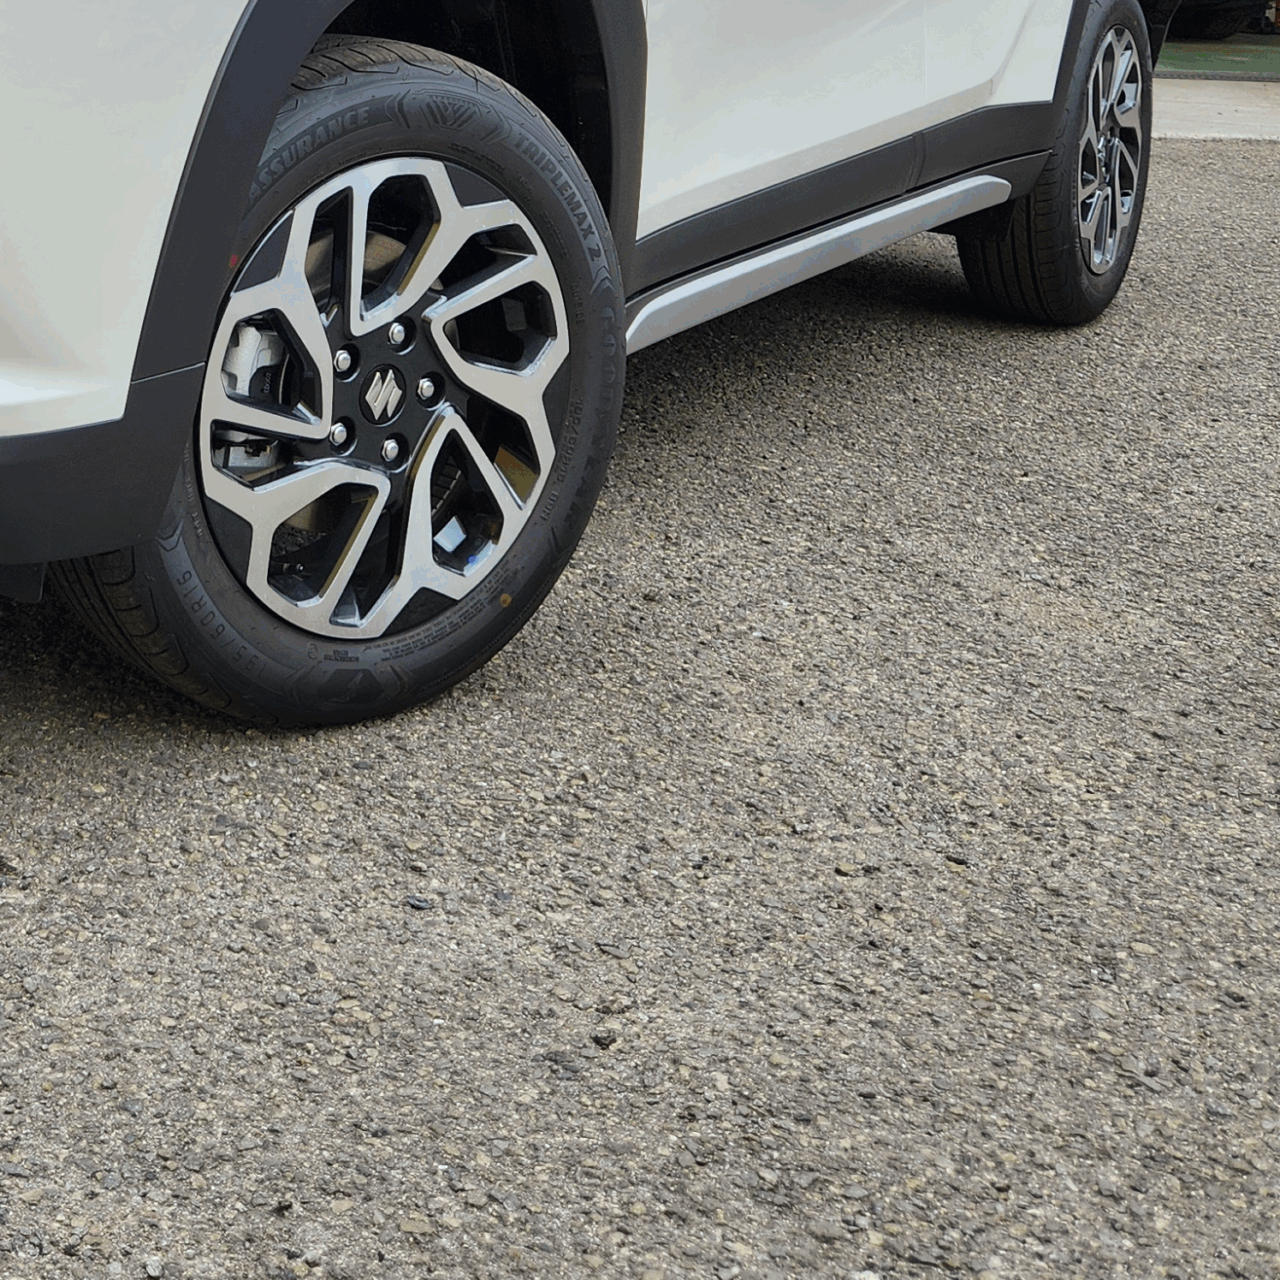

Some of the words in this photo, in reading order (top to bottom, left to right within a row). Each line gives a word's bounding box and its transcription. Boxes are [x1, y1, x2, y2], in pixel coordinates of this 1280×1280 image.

[513, 131, 596, 242] TRIPLEMAX
[586, 239, 603, 262] 2
[176, 569, 266, 677] 195/60R16
